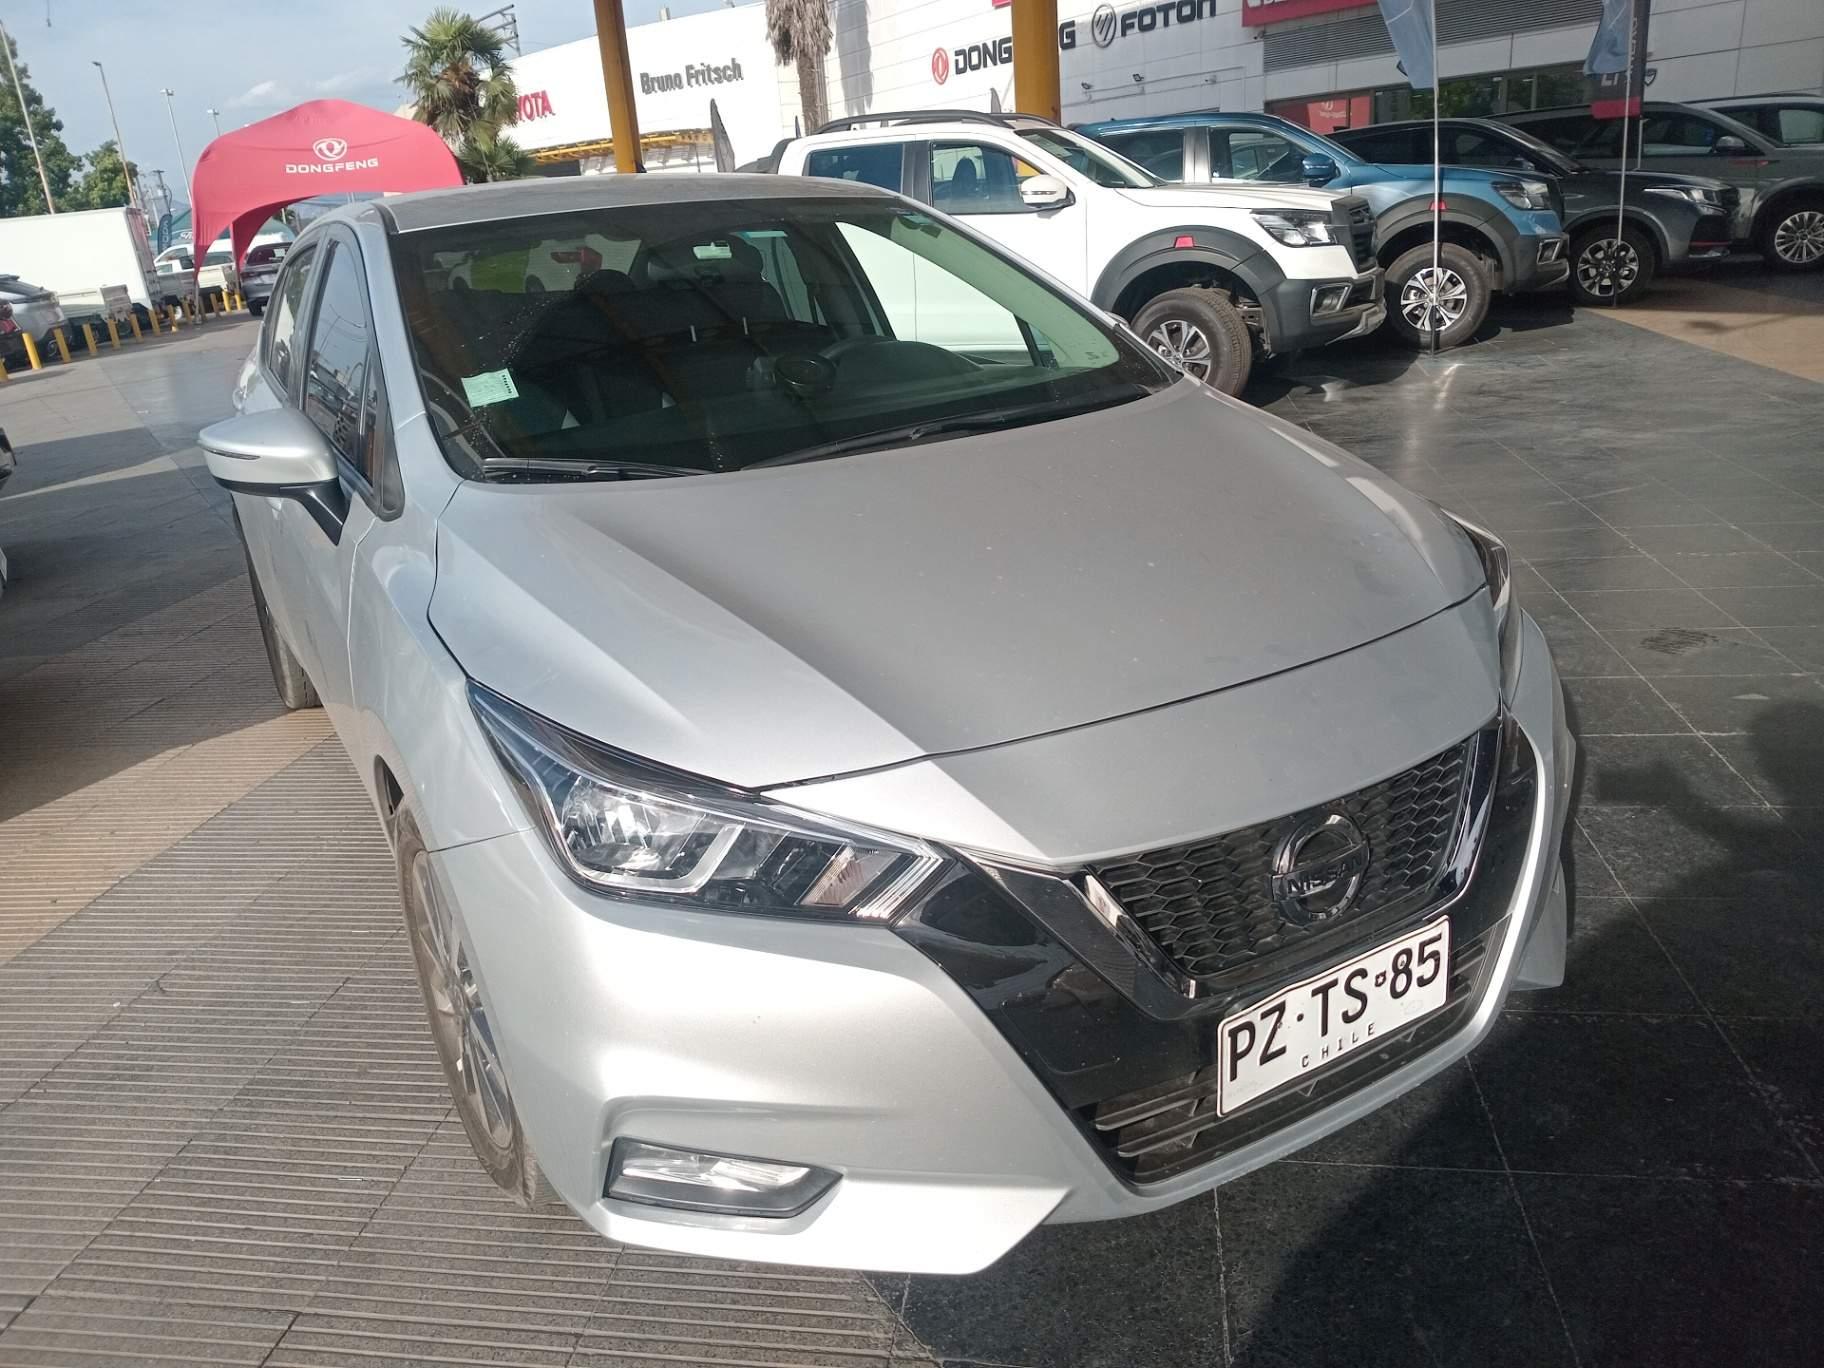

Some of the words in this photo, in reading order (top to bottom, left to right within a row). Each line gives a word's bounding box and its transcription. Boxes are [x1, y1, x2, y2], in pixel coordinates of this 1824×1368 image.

[1121, 0, 1215, 37] FOTON
[954, 20, 1076, 75] DONGG
[640, 72, 684, 95] Bruno
[685, 57, 744, 87] Fritsch
[285, 158, 379, 174] DONGFENG
[1301, 1022, 1376, 1069] CHILE
